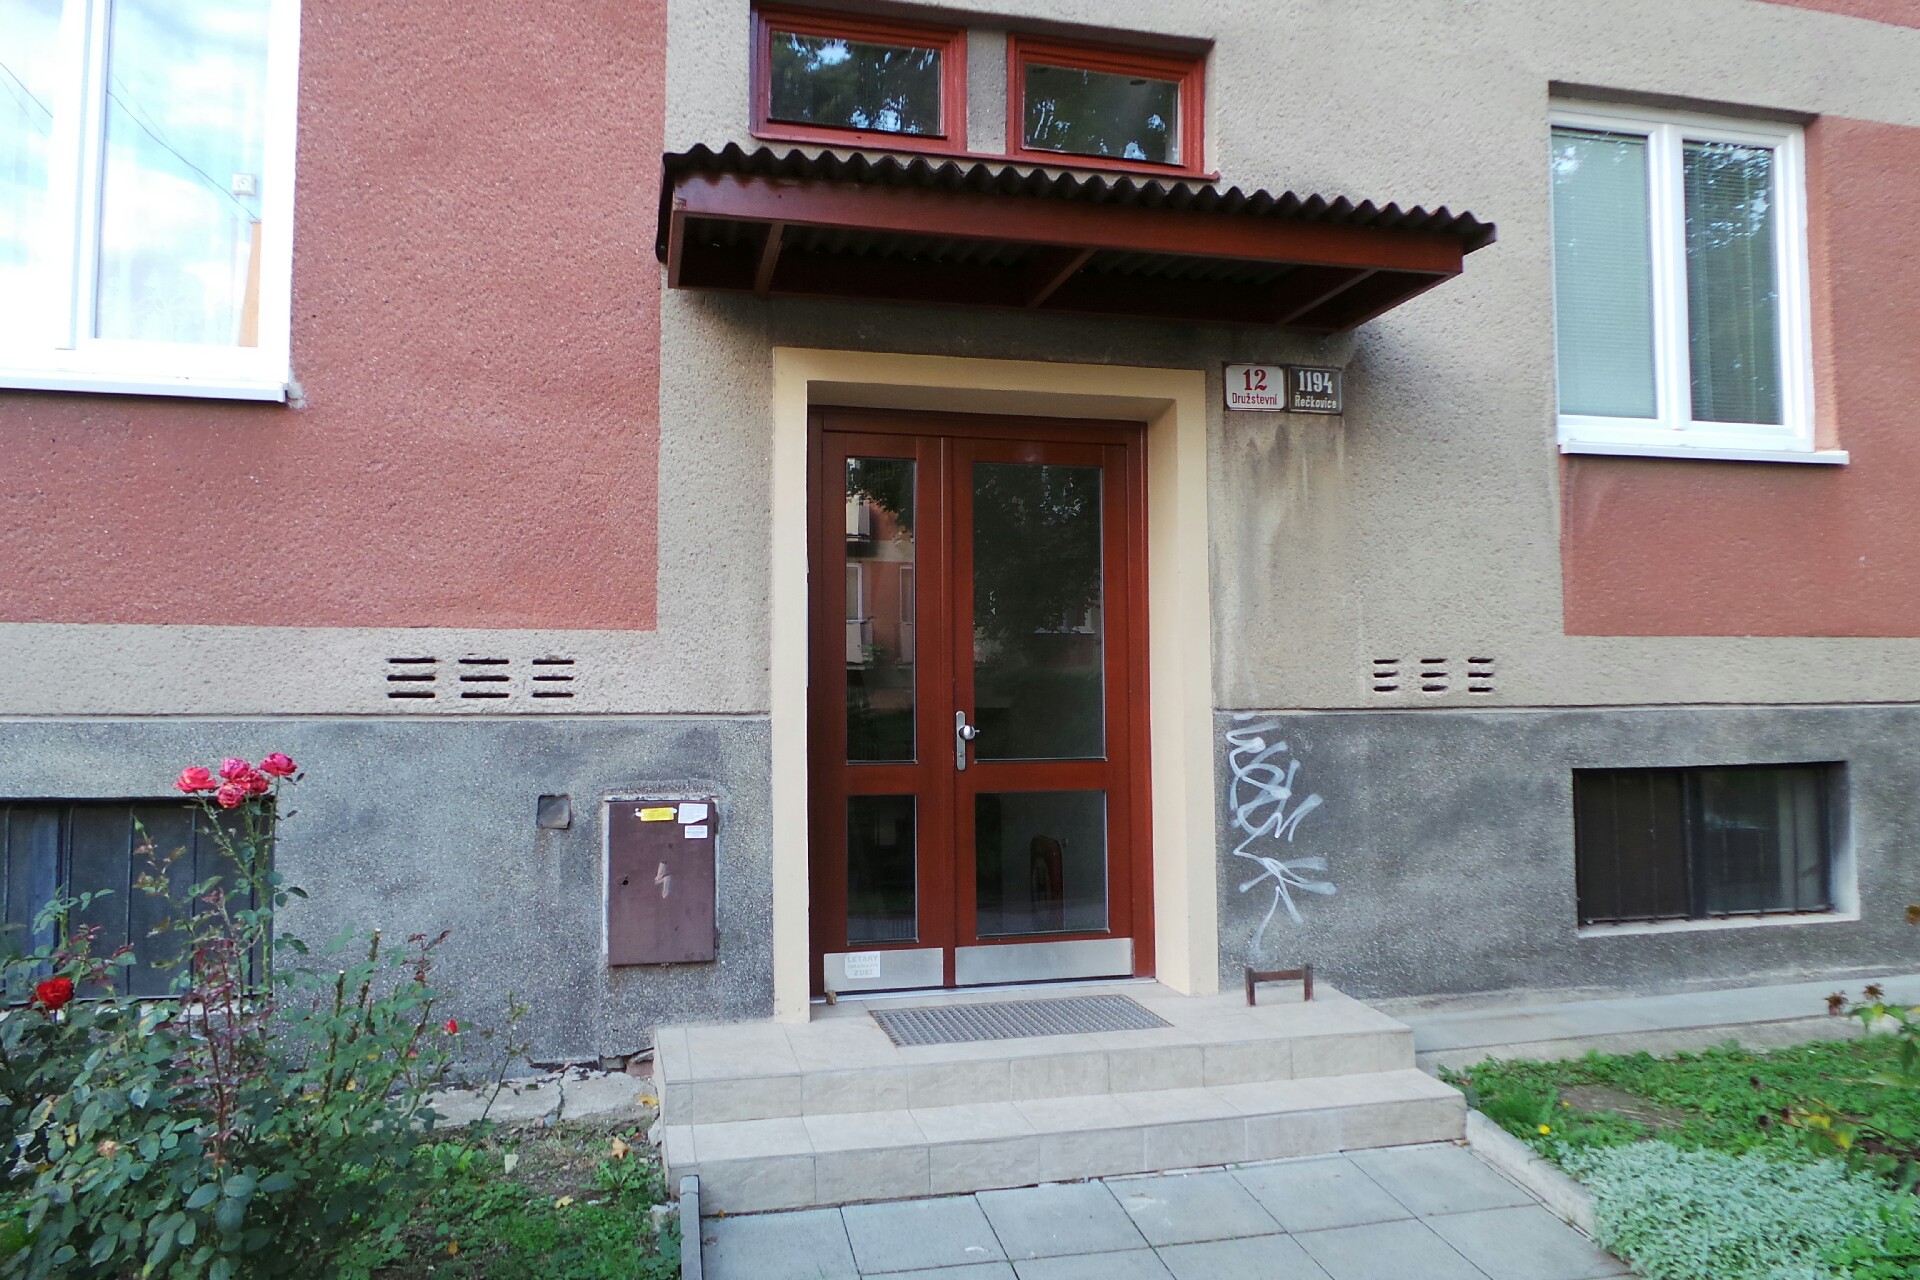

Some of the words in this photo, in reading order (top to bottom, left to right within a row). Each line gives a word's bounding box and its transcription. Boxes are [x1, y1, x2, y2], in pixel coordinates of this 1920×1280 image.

[1243, 368, 1268, 391] 12
[1299, 370, 1333, 394] 1194
[1232, 392, 1278, 406] Družstevní
[1294, 392, 1337, 409] Řečkovice
